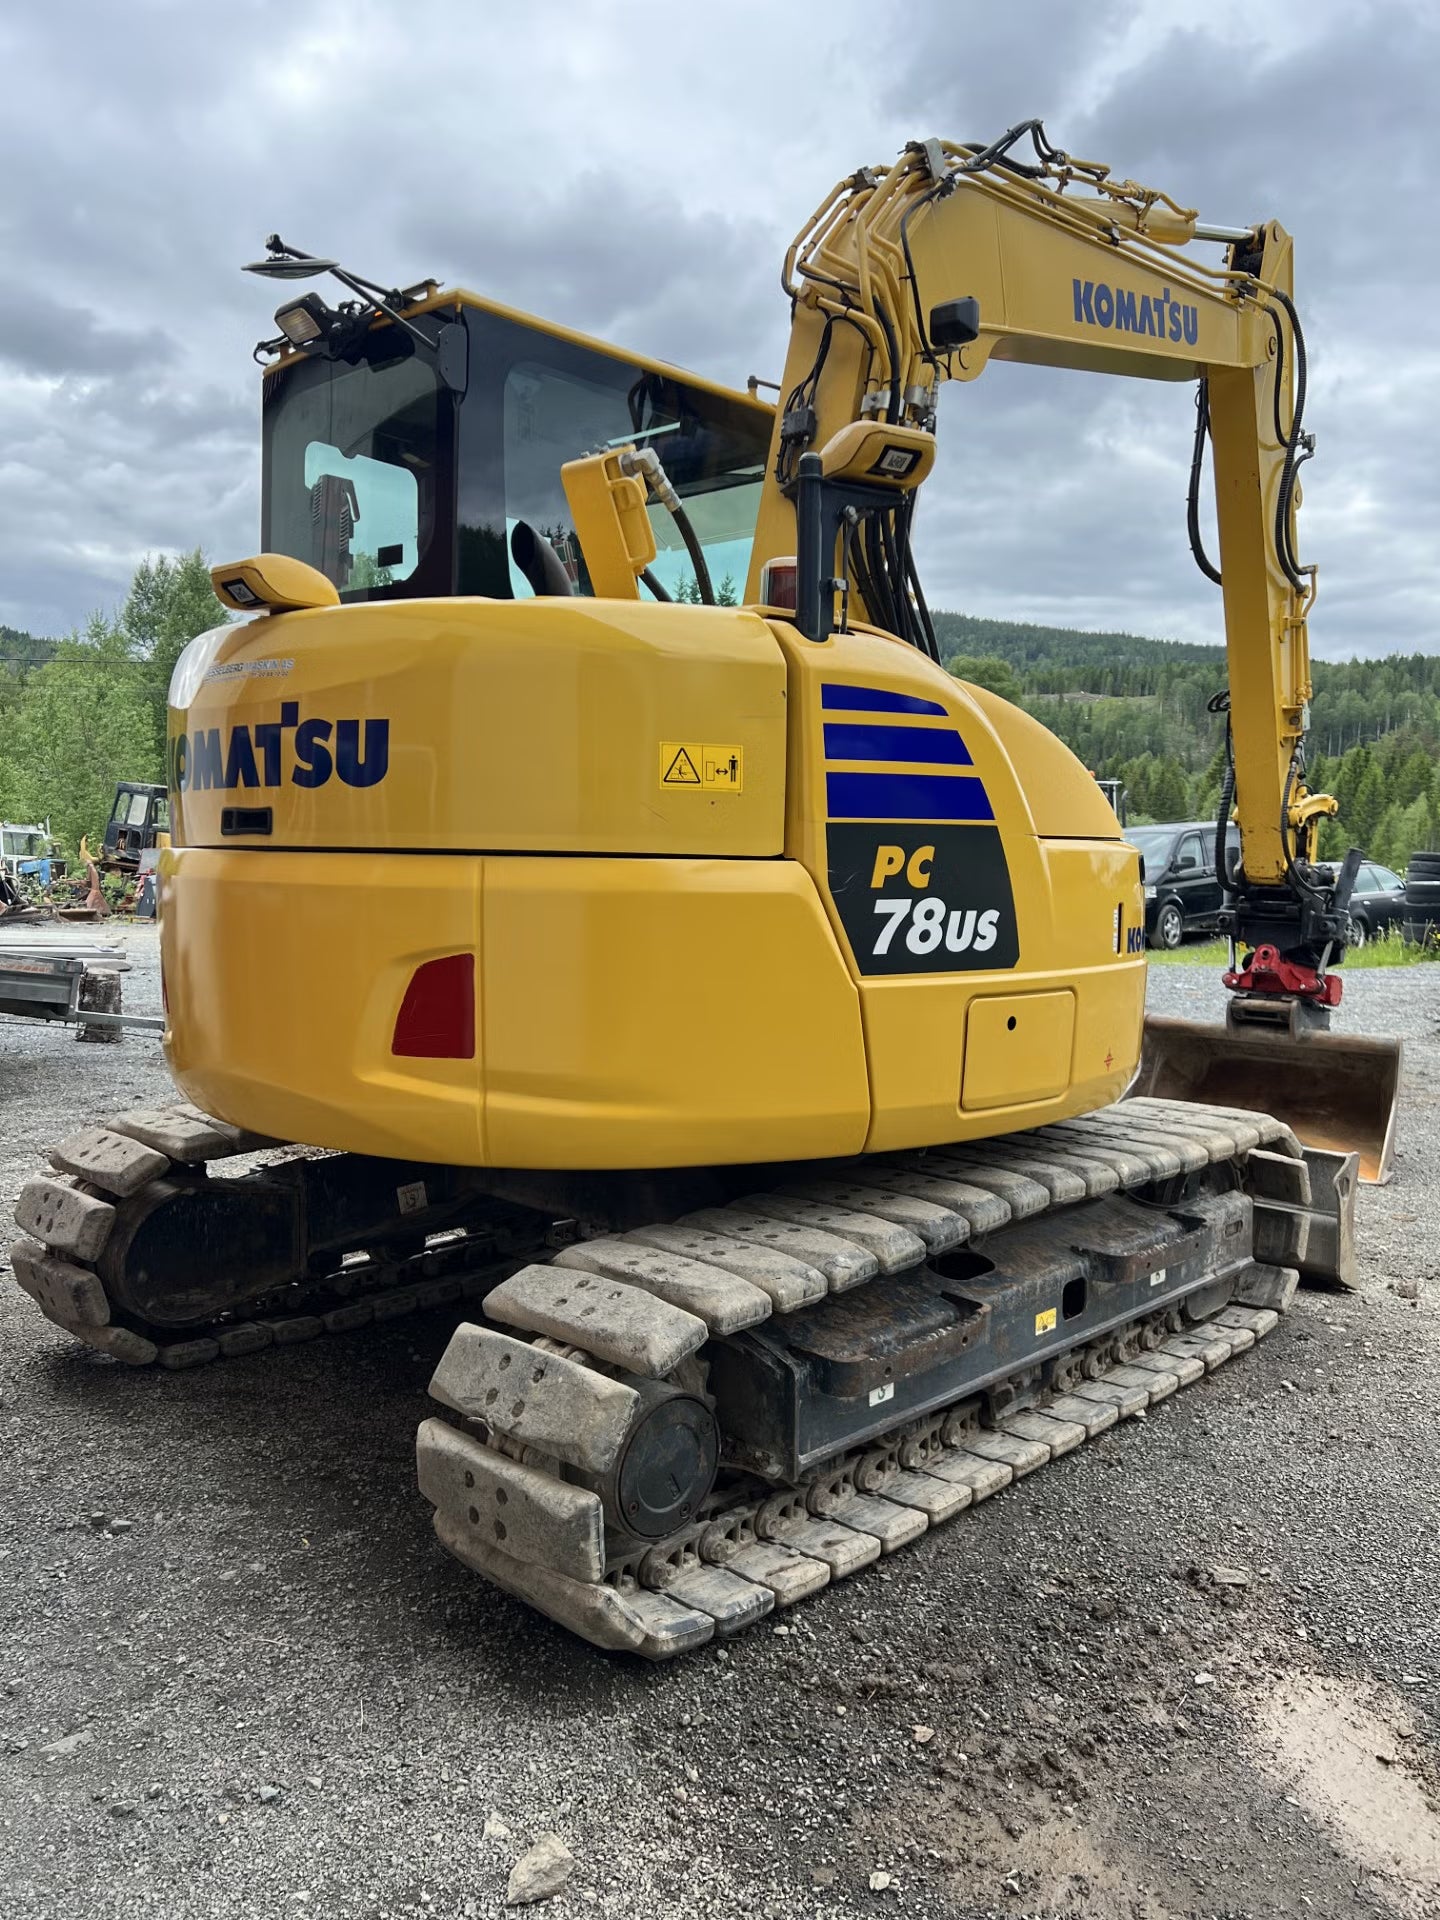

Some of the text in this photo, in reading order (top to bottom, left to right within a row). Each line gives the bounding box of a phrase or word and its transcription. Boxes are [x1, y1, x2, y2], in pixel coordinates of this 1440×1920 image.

[1073, 279, 1198, 345] KOMATSU
[870, 845, 936, 889] PC
[872, 897, 1001, 955] 78US
